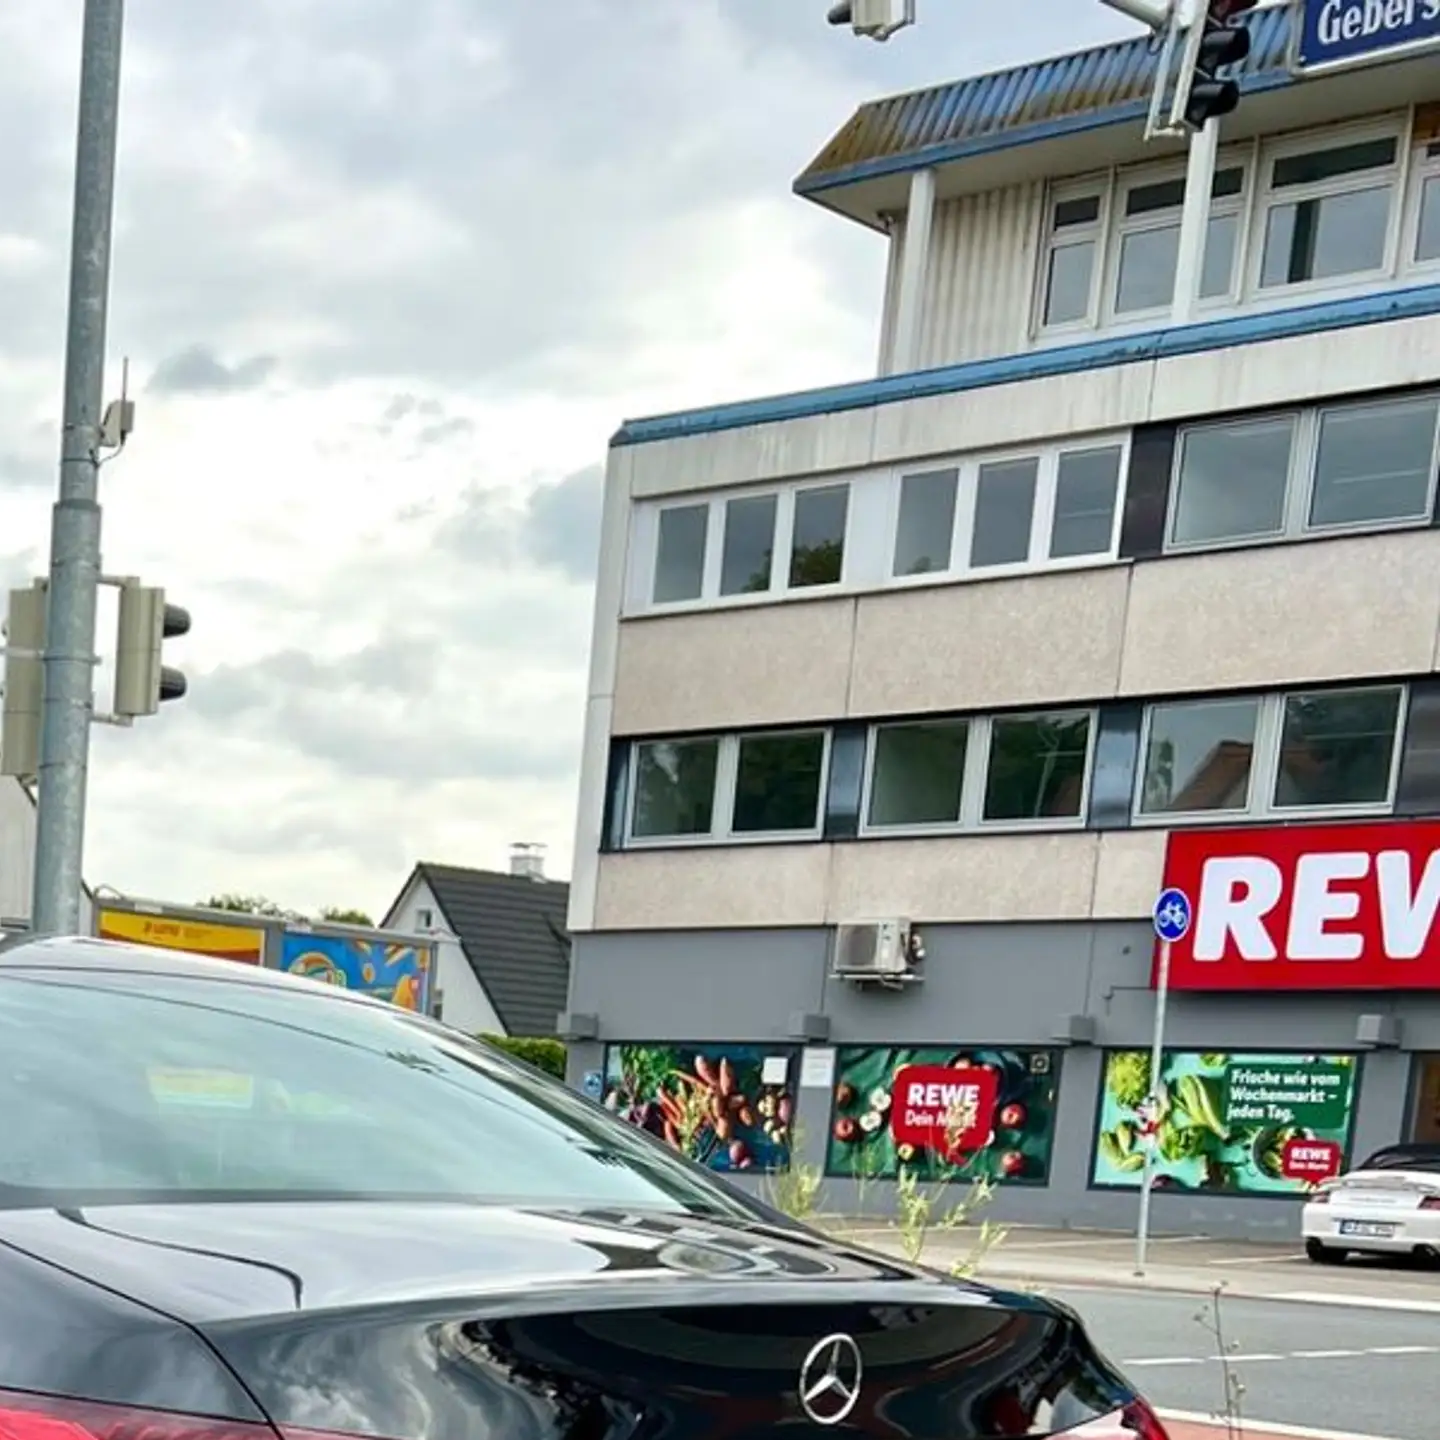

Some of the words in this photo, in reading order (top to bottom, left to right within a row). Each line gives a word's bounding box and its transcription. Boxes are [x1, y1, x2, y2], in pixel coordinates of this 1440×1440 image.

[1231, 1068, 1280, 1085] Frische
[1283, 1070, 1308, 1086] wie
[906, 1082, 980, 1107] REWE
[1230, 1086, 1326, 1103] Wochenmarkt
[904, 1109, 934, 1127] Dein
[1226, 1103, 1264, 1122] jeden
[1267, 1104, 1295, 1123] Tag.
